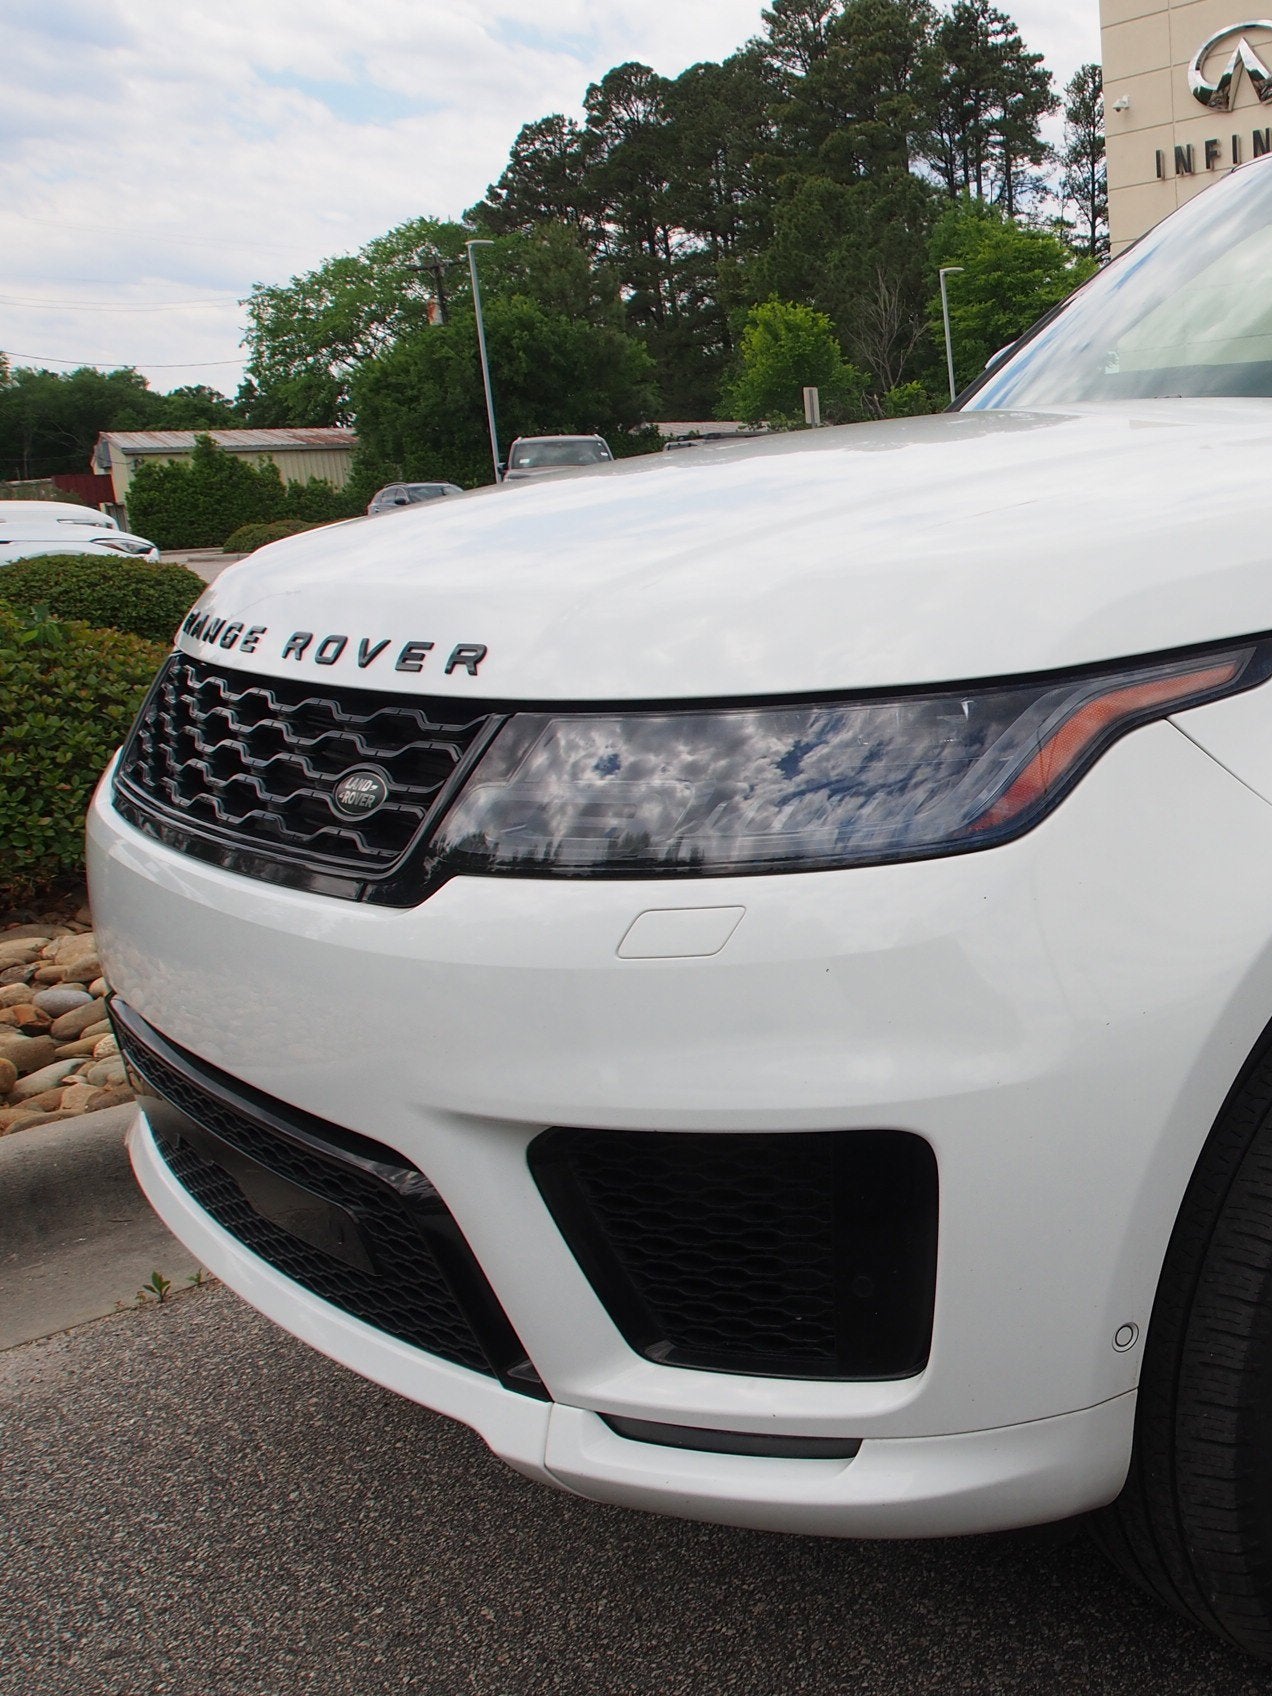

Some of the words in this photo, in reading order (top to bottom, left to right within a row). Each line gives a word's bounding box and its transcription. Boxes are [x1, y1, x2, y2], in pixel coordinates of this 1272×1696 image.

[182, 611, 268, 654] RANGE
[281, 631, 488, 676] ROVER
[341, 790, 376, 808] ROVER
